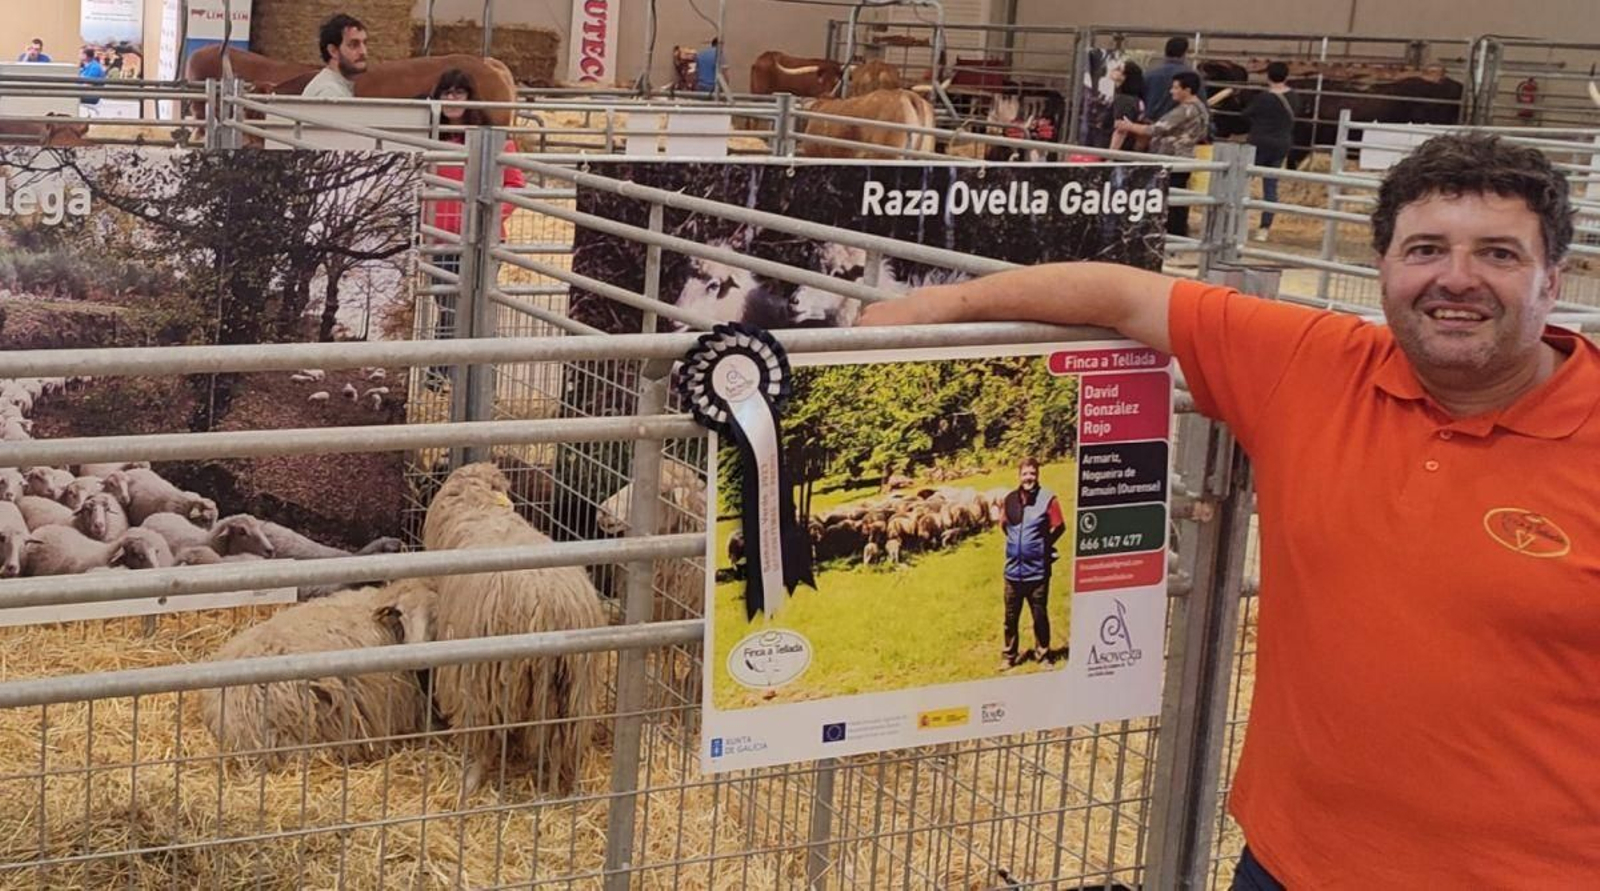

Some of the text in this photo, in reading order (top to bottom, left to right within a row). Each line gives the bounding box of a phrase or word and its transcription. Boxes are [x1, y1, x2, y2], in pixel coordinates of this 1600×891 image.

[206, 11, 249, 20] LIMSIN
[862, 181, 1164, 222] Raza Ovella Galega
[1065, 352, 1156, 369] Finca a Tellada
[1084, 384, 1119, 399] David
[1084, 401, 1140, 417] González
[1083, 421, 1111, 437] Rojo
[1082, 452, 1122, 465] Armariz,
[1081, 467, 1136, 482] Nogueira de
[1117, 480, 1161, 496] (Ourense)
[1079, 533, 1143, 550] 666 147 477
[744, 647, 766, 658] Finca
